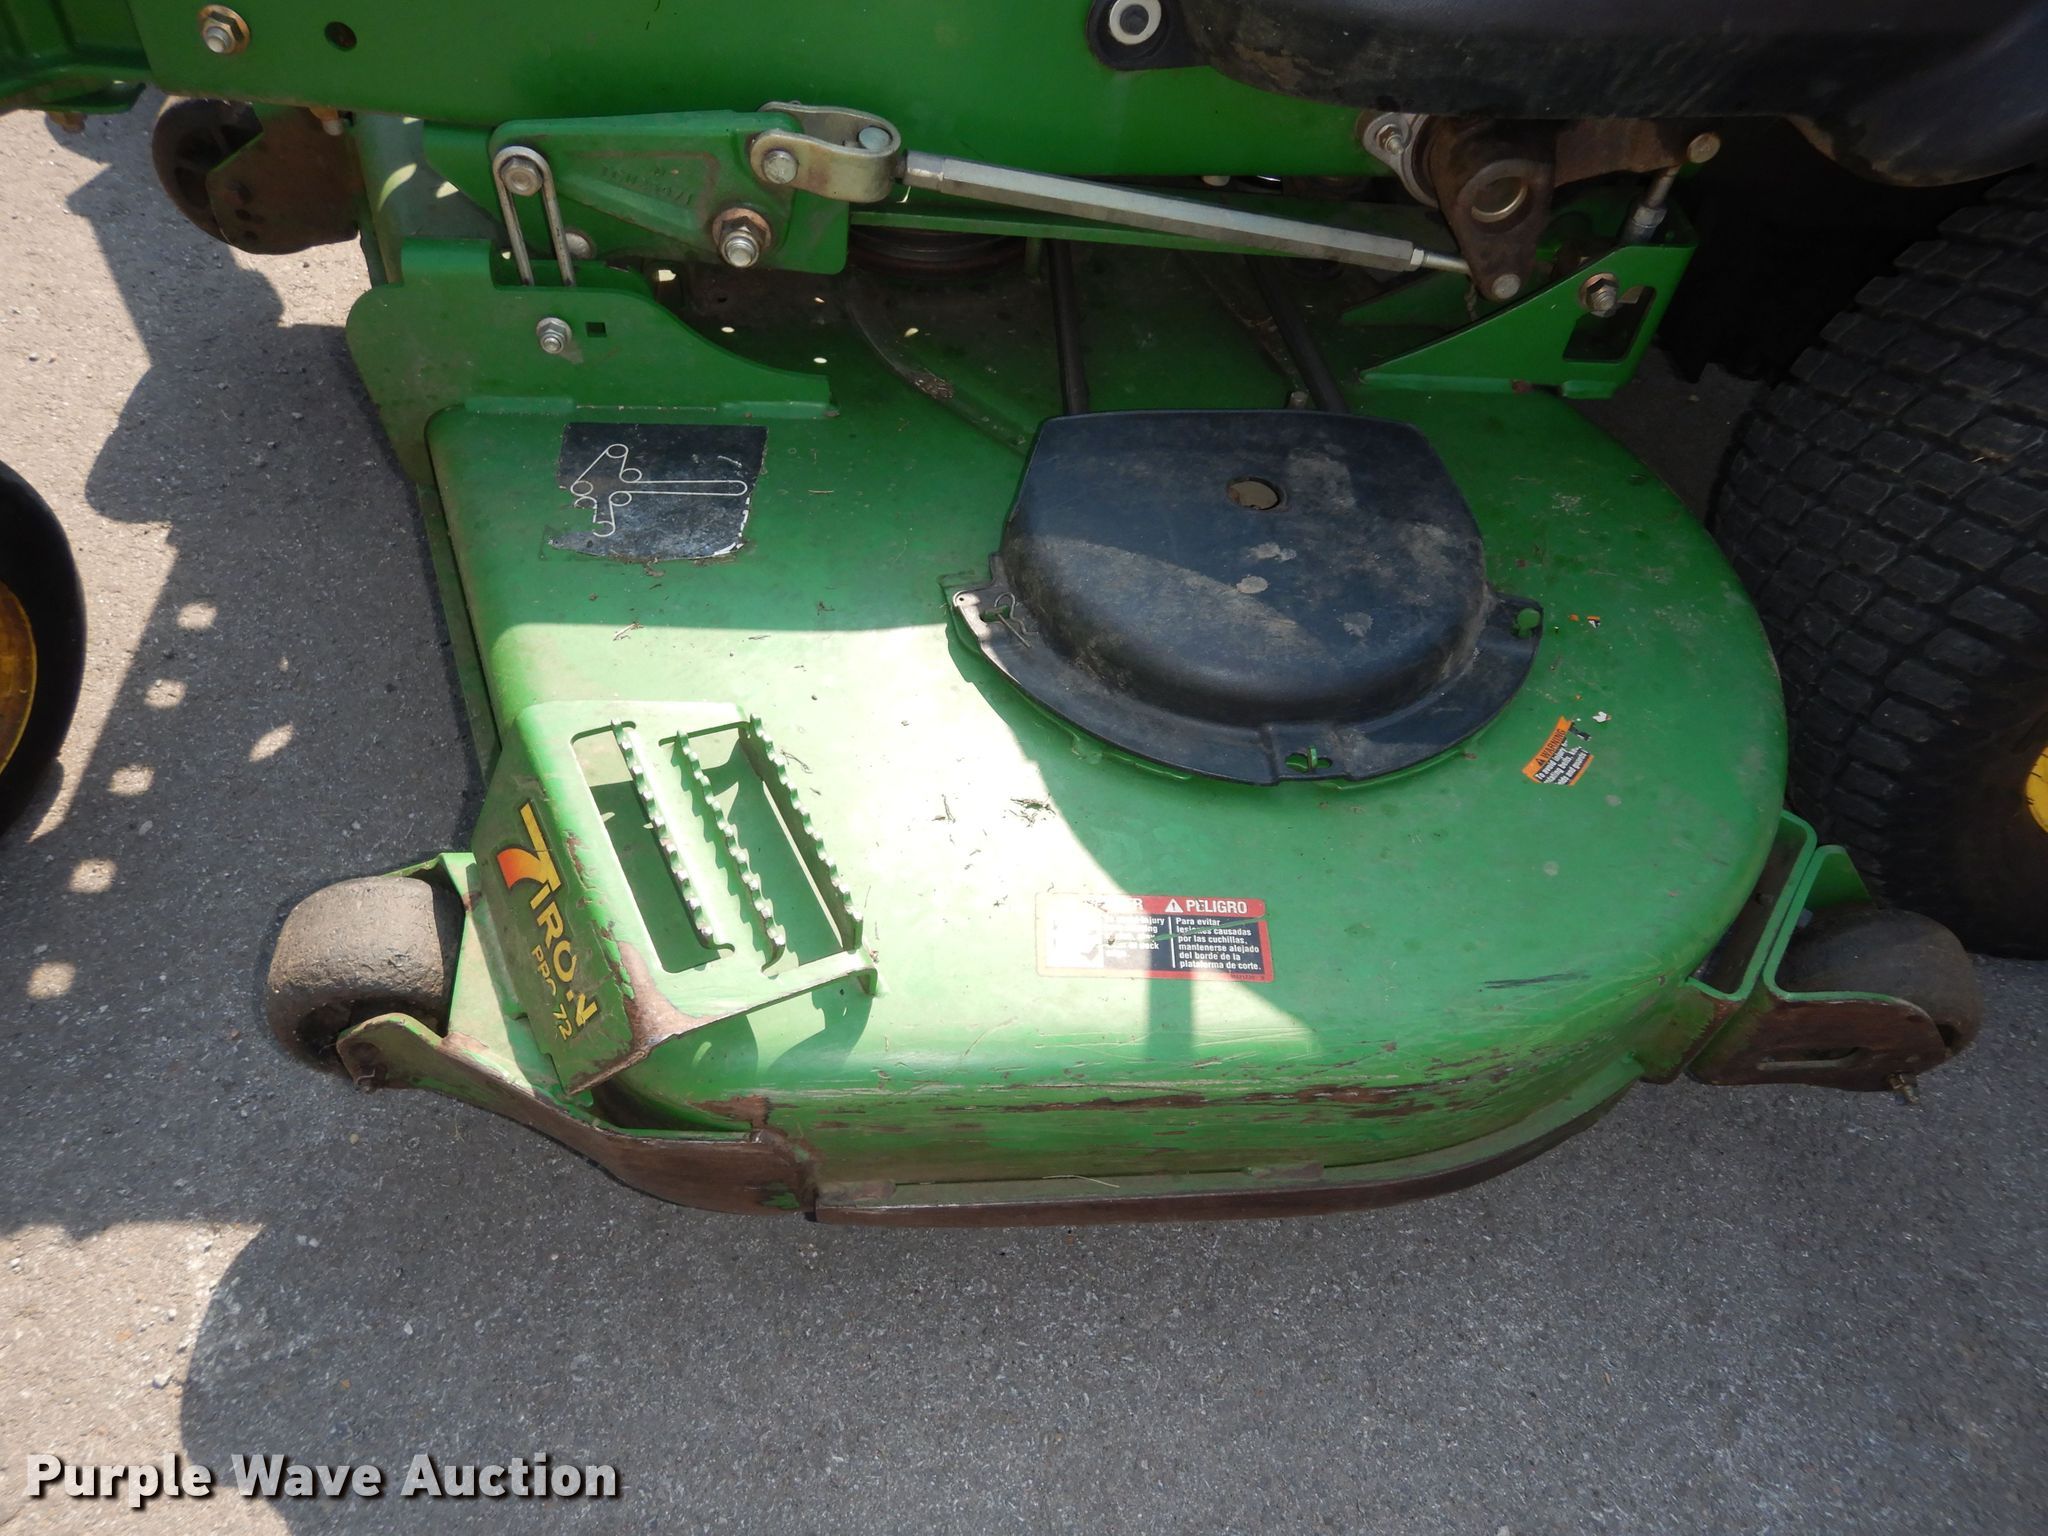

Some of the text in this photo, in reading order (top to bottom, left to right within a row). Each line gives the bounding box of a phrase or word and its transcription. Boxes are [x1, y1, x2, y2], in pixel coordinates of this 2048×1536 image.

[1540, 728, 1566, 758] WARNING
[1185, 899, 1248, 914] PELIGRO
[1175, 917, 1221, 927] Para evitar
[1213, 928, 1252, 936] causadas
[1178, 936, 1192, 945] por
[1193, 934, 1207, 944] las
[1178, 944, 1260, 954] mantenerse alejado
[1179, 951, 1241, 962] del borde de la
[1179, 960, 1262, 971] plataforma de corte.
[553, 1004, 573, 1041] 72
